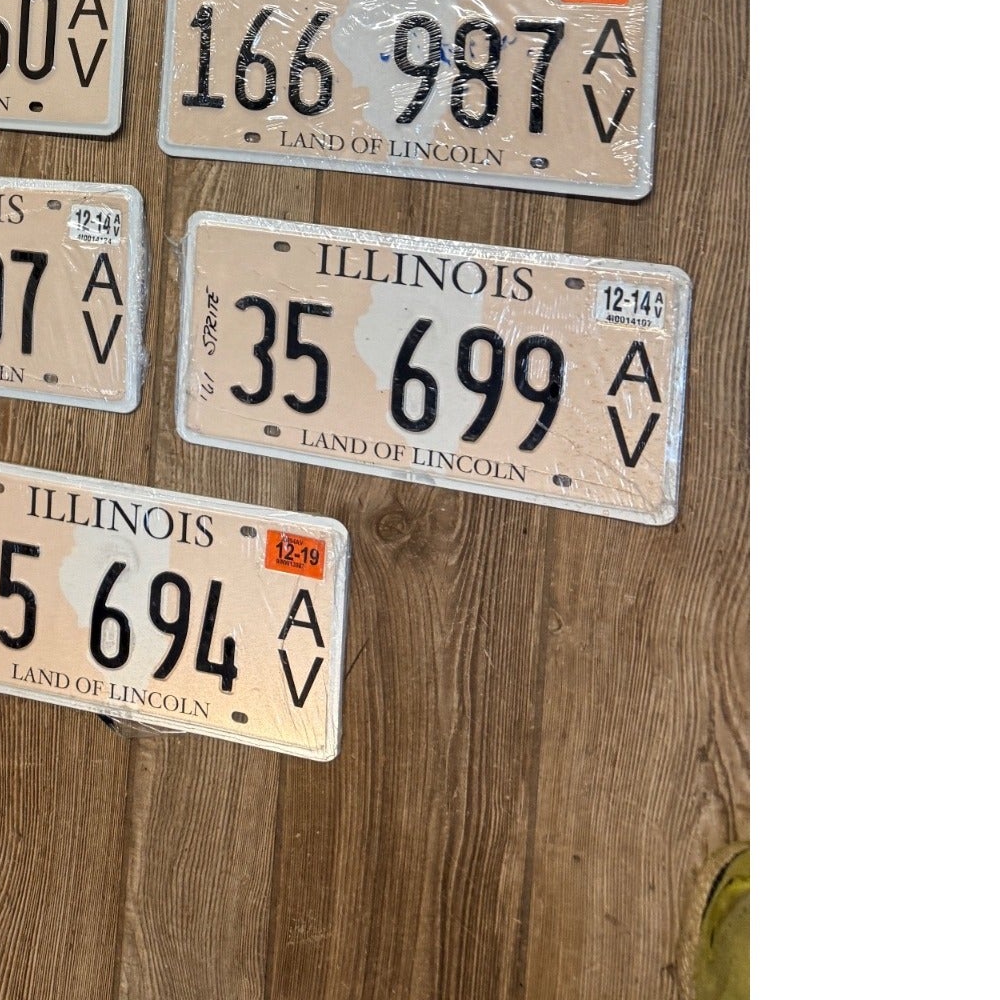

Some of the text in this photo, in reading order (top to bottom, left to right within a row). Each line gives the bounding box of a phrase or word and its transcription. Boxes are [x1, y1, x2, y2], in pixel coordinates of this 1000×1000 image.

[181, 5, 567, 134] 166 987
[280, 129, 504, 168] LAND OF LINCOLN
[75, 209, 111, 234] 12-14
[316, 243, 534, 301] ILLINOIS
[604, 286, 651, 315] 12-14
[202, 285, 219, 355] SPRITE
[230, 295, 565, 451] 35 699
[301, 429, 528, 483] LAND OF LINCOLN
[26, 485, 215, 549] ILLINOIS
[276, 541, 319, 565] 12-19
[89, 561, 238, 694] 694
[12, 663, 211, 720] LAND OF LINCOLN
